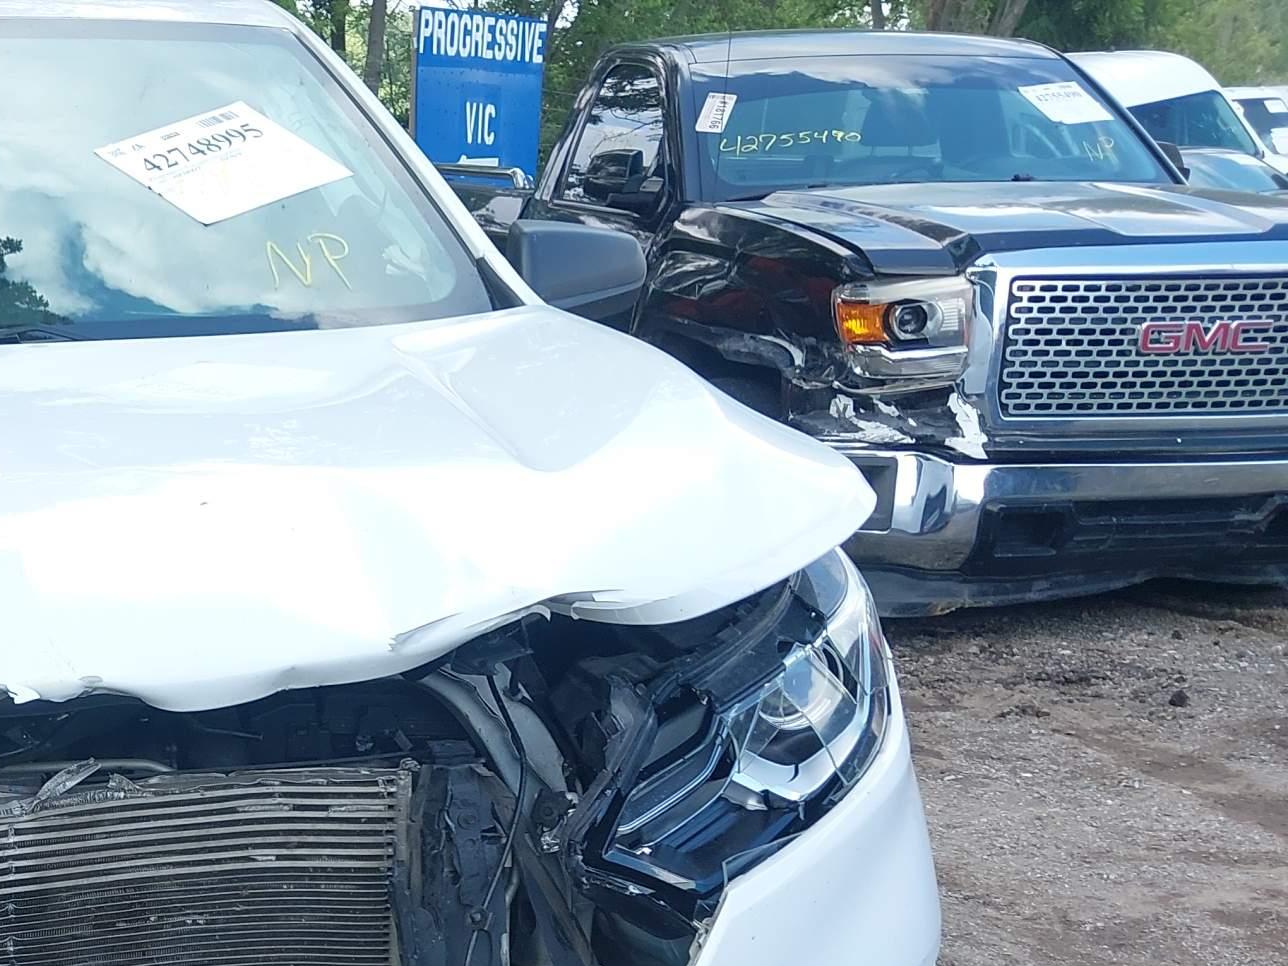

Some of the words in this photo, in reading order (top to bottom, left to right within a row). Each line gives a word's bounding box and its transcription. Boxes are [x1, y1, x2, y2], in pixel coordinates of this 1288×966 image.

[419, 9, 546, 64] PROGRESSIVE
[143, 123, 264, 173] 42748995
[466, 101, 496, 145] VIC
[266, 233, 352, 290] NP
[1139, 320, 1274, 353] GMC
